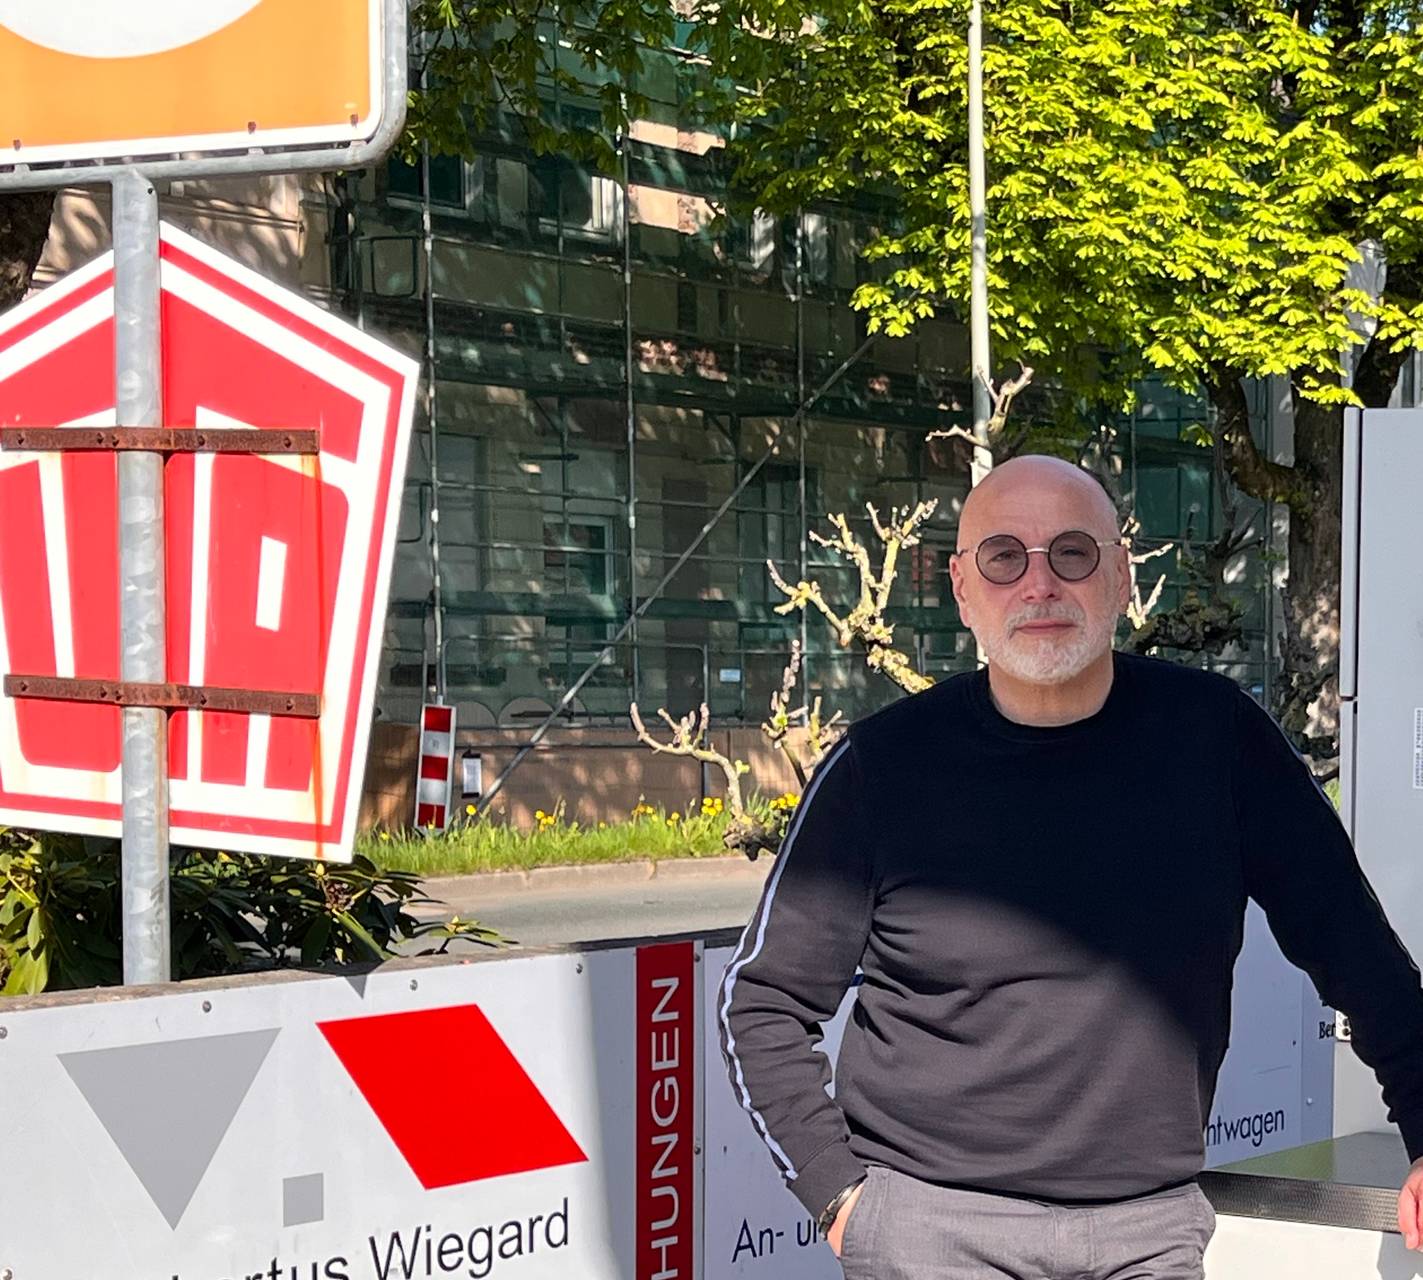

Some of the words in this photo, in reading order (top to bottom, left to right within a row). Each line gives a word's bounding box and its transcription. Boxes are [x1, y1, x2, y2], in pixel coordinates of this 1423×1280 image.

[651, 977, 680, 1280] HUNGEN
[368, 1197, 569, 1280] Wiegard
[732, 1218, 784, 1263] An-
[796, 1218, 818, 1247] u
